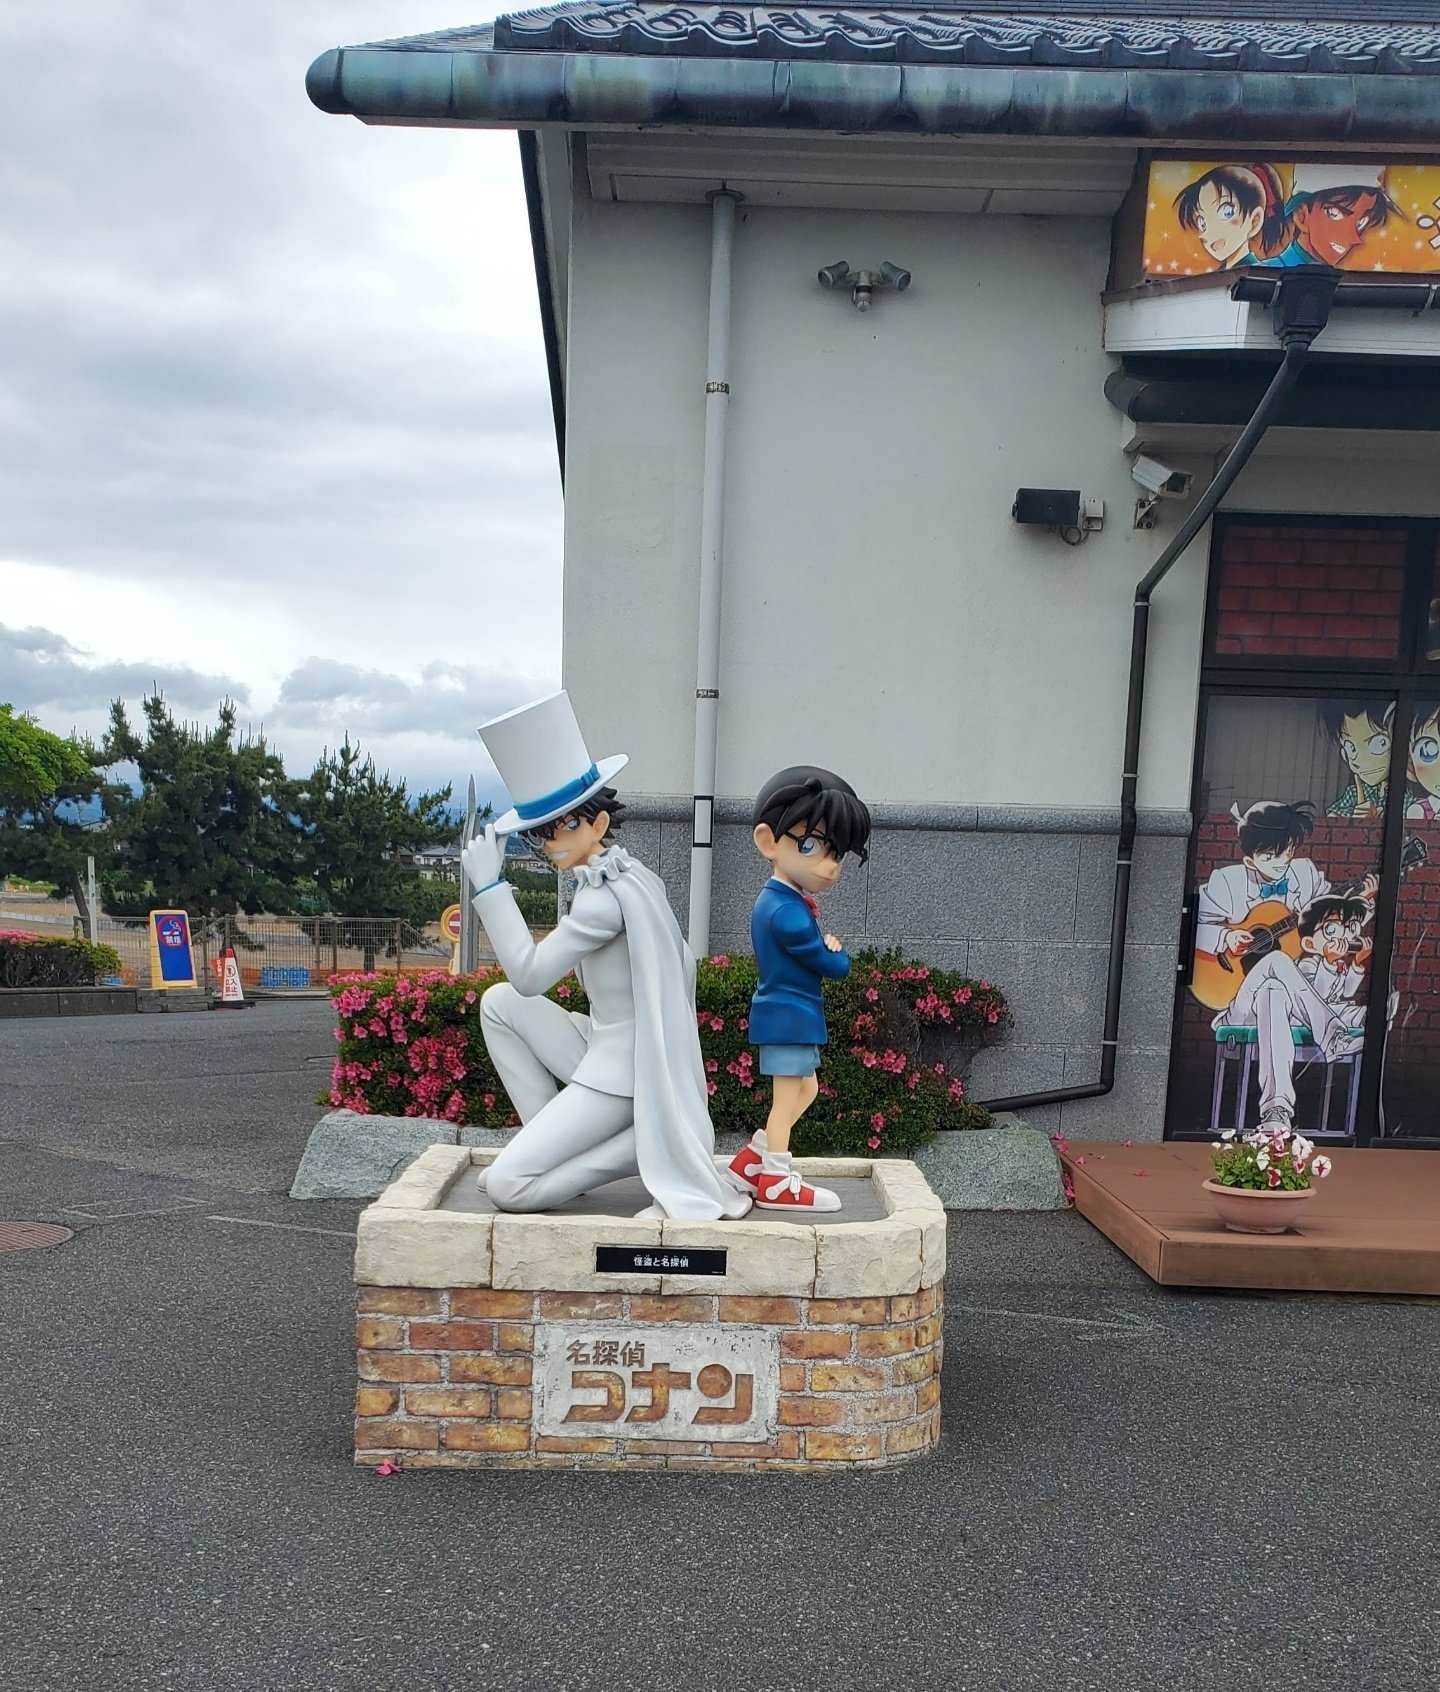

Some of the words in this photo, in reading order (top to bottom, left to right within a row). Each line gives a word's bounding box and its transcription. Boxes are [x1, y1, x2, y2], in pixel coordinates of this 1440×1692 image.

[633, 1256, 689, 1268] 怪盗と名探偵
[566, 1339, 645, 1367] 名探偵
[561, 1362, 754, 1425] コナン
